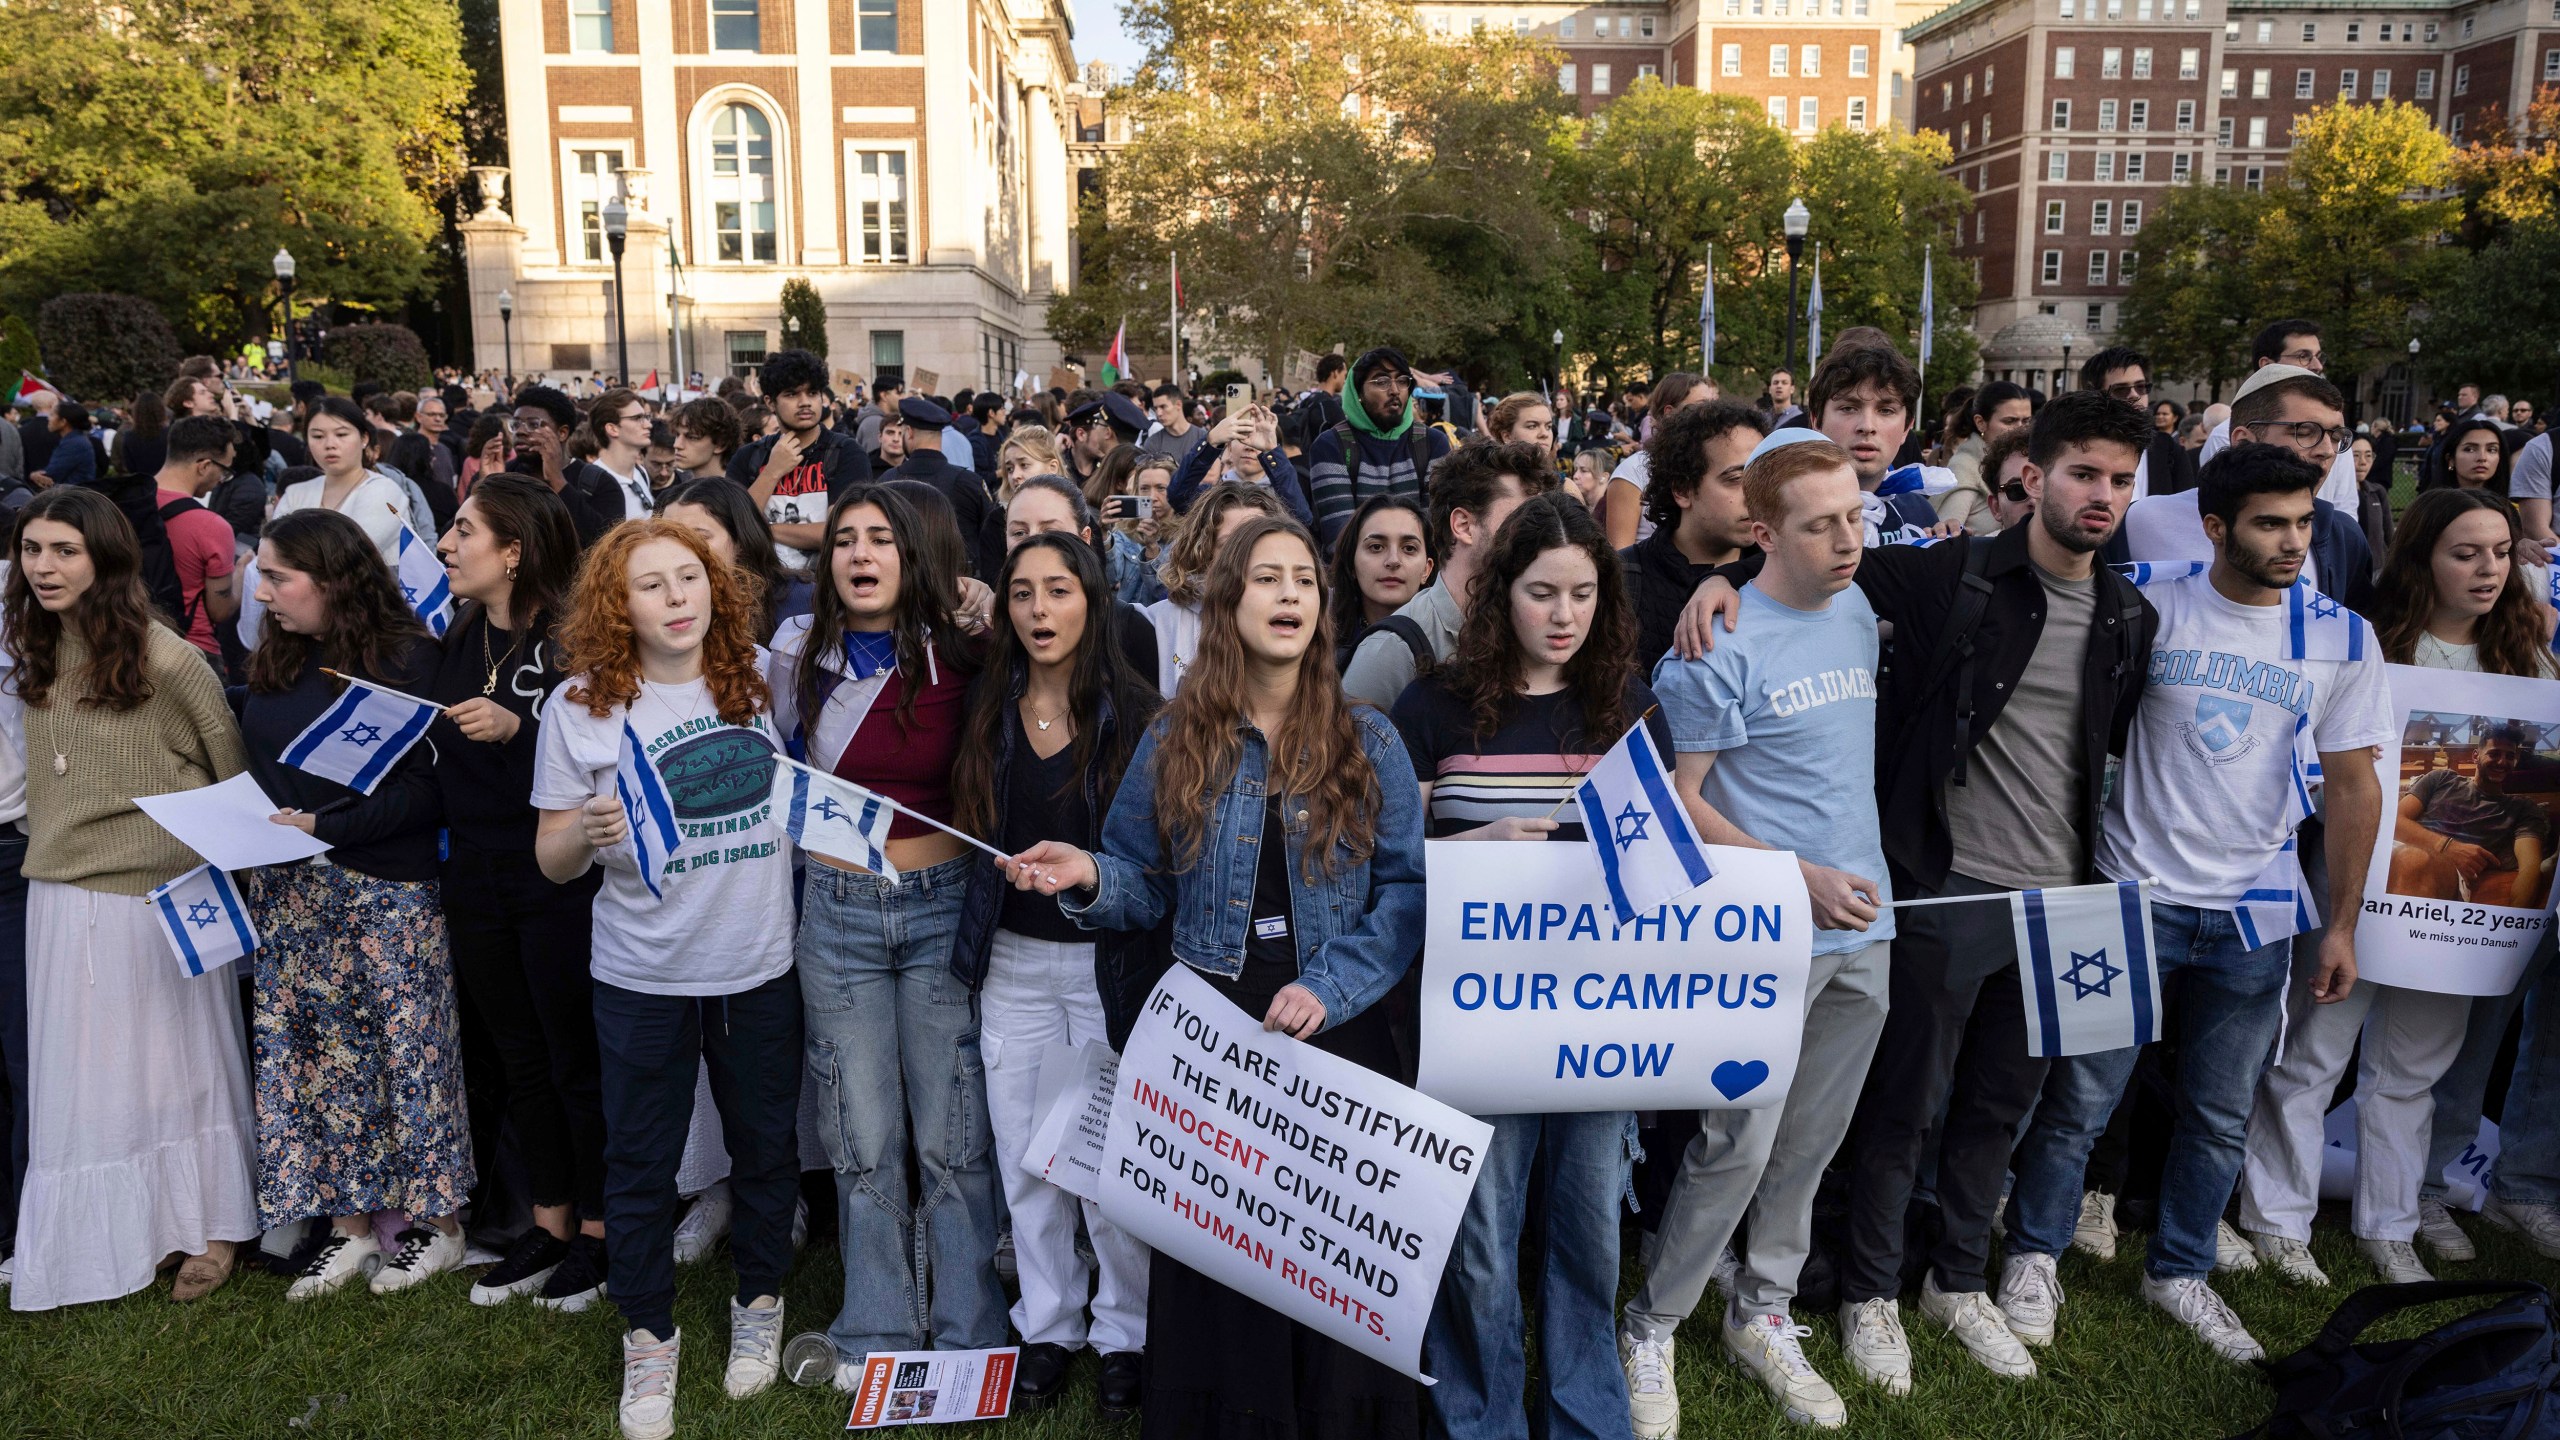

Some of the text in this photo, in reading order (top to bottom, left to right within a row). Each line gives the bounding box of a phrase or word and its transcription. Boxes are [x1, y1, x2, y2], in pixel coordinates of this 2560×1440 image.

[2148, 650, 2314, 715] COLUMBIA
[646, 714, 770, 757] RCHAEOLOAL
[678, 804, 771, 838] SEMINARS
[663, 858, 686, 875] WE
[692, 850, 719, 870] DIG
[1714, 904, 1781, 942] ON
[2361, 896, 2393, 916] an
[2398, 901, 2455, 926] Ariel,
[2461, 908, 2487, 926] 22
[2489, 914, 2542, 932] years
[2409, 929, 2519, 949] We miss you Danush
[1452, 972, 1778, 1011] OUR CAMPUS
[1555, 1043, 1675, 1079] NOW
[1150, 989, 1475, 1175] IF YOU ARE JUSTIFYING
[1080, 1114, 1094, 1125] say
[1088, 1103, 1102, 1114] The
[1171, 1054, 1401, 1194] THE MURDER OF
[1078, 1124, 1100, 1137] there
[1068, 1155, 1095, 1173] Hamas
[1133, 1078, 1423, 1261] INNOCENT CIVILIANS
[1135, 1121, 1398, 1299] YOU DO NOT STAND
[1119, 1157, 1391, 1342] FOR HUMAN RIGHTS.
[860, 1363, 887, 1422] KIDNAPPED
